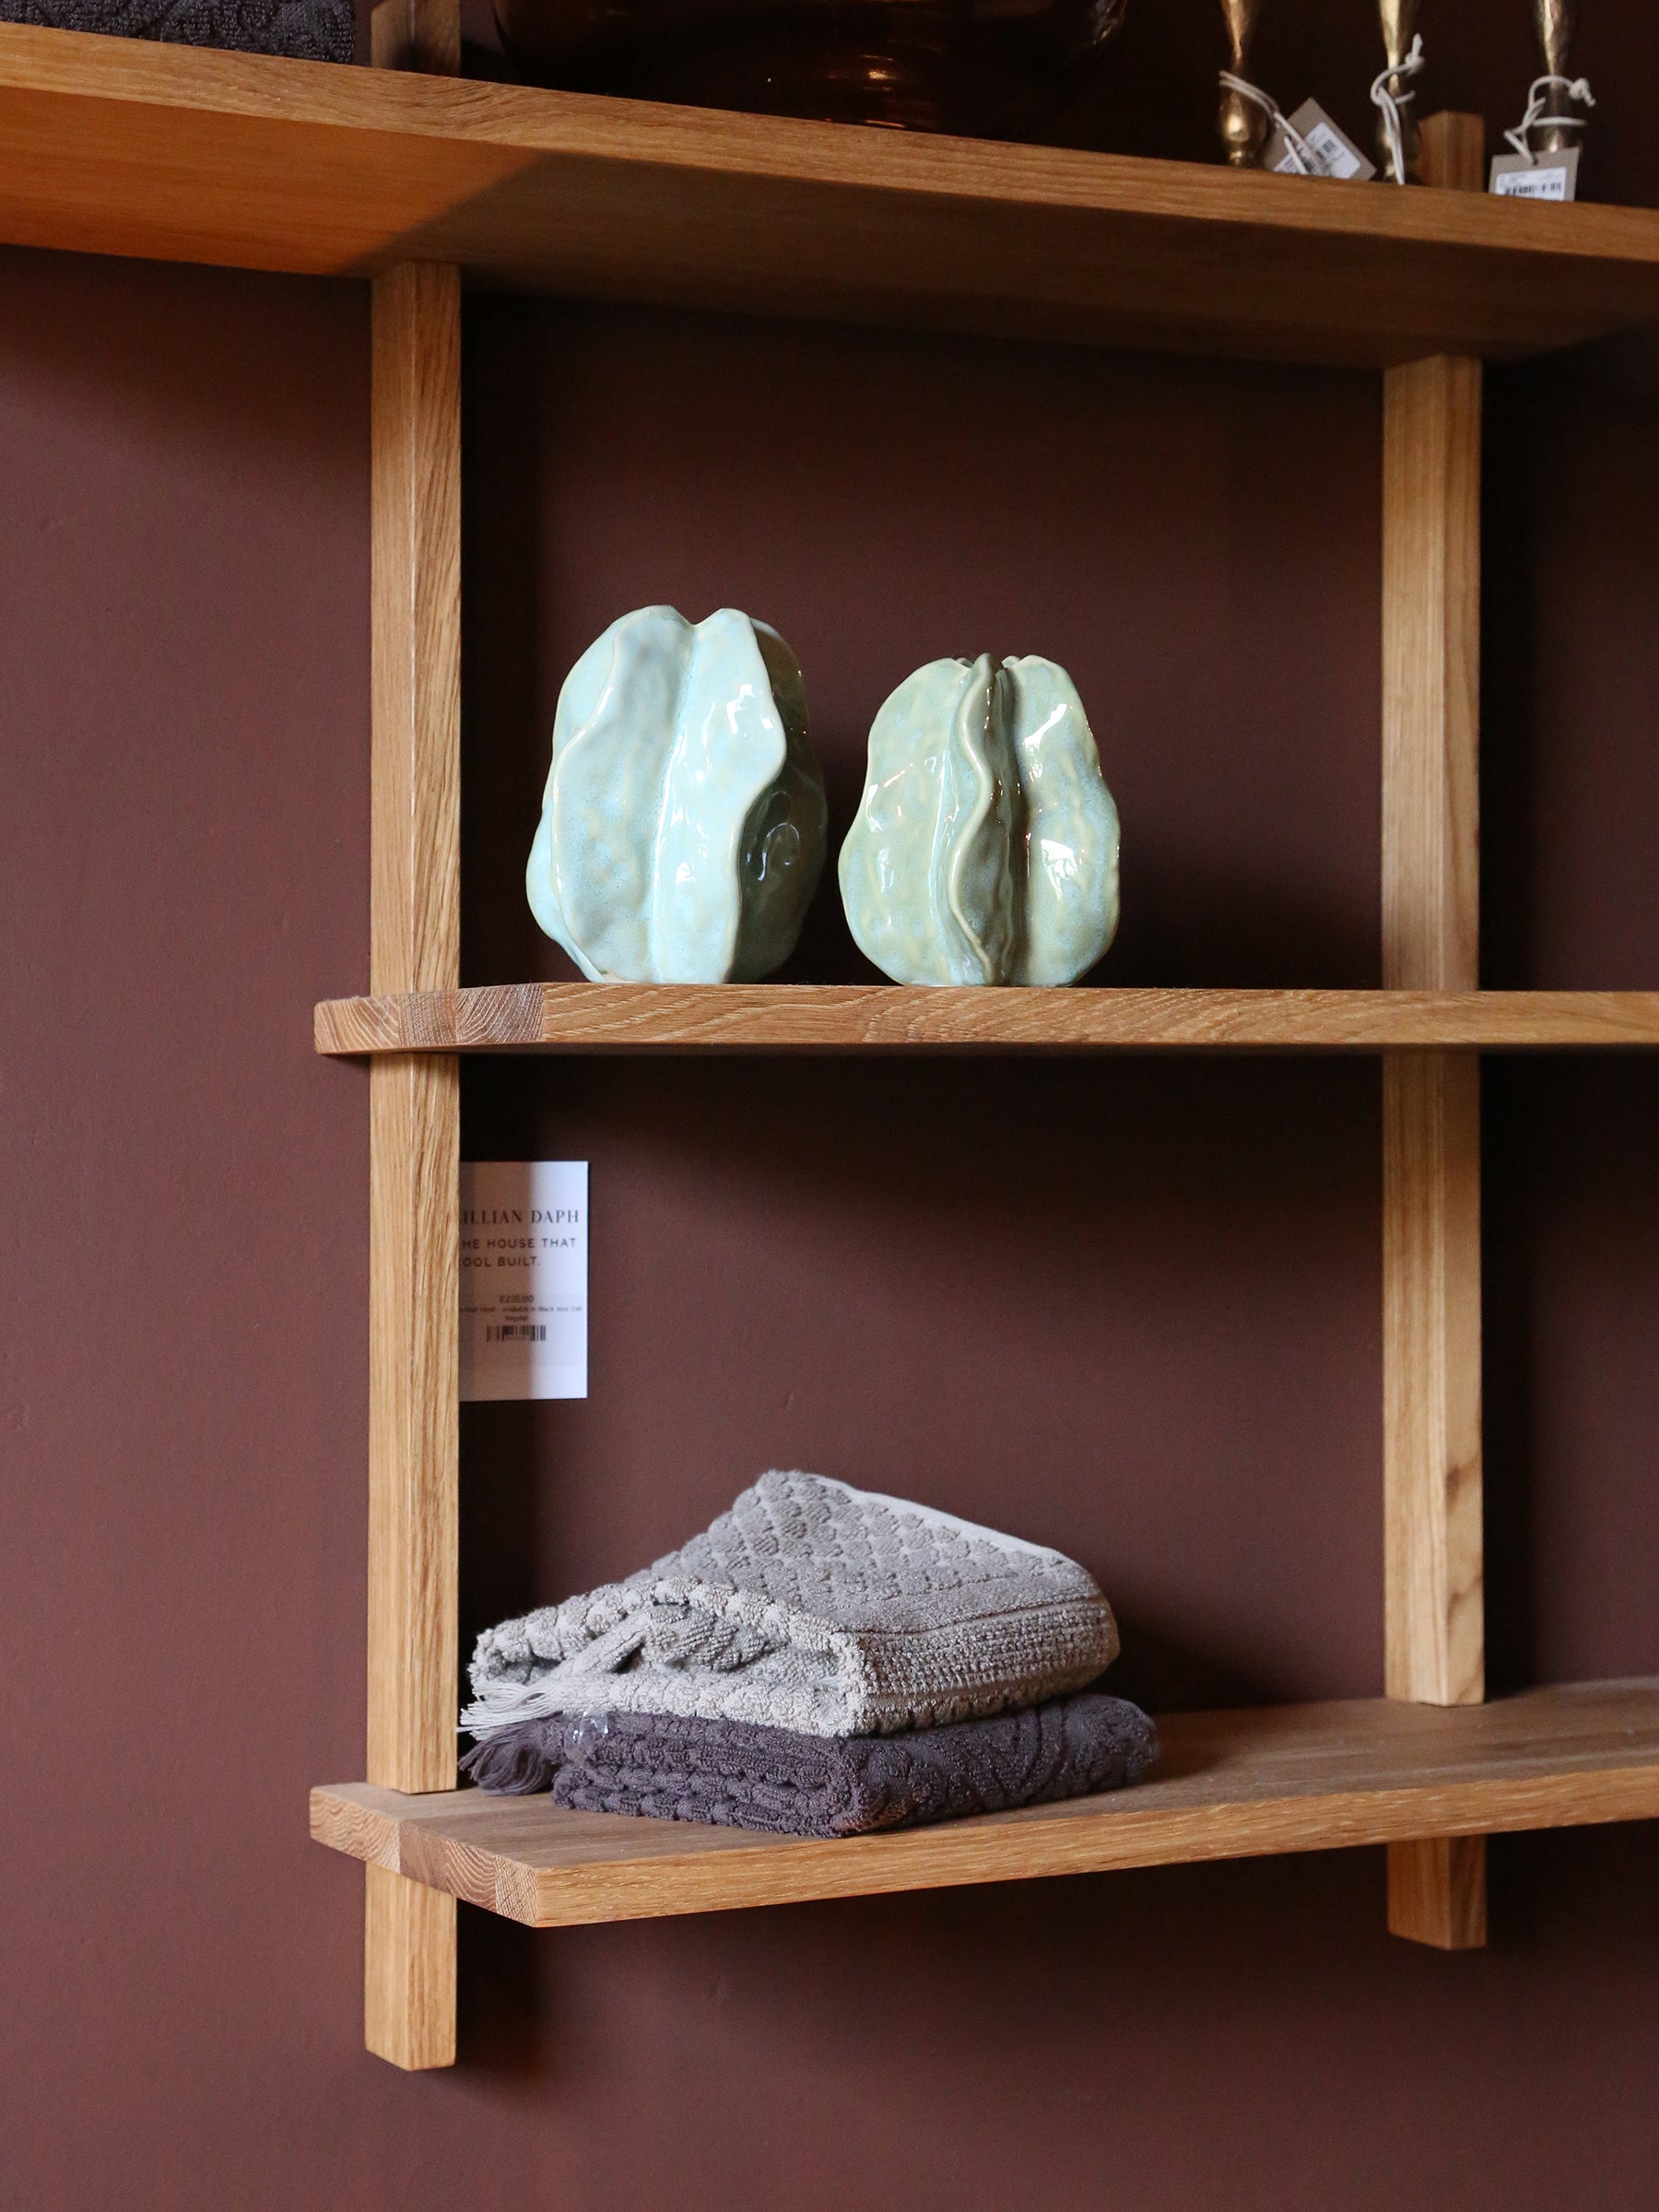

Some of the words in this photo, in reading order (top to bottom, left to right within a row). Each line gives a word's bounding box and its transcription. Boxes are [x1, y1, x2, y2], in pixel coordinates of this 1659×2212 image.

[460, 1209, 523, 1224] ILLIAN
[531, 1209, 579, 1223] DAPH
[462, 1238, 480, 1249] HE
[487, 1238, 535, 1249] HOUSE
[541, 1238, 576, 1247] THAT
[460, 1257, 492, 1267] OOL
[498, 1256, 540, 1266] BUILT.
